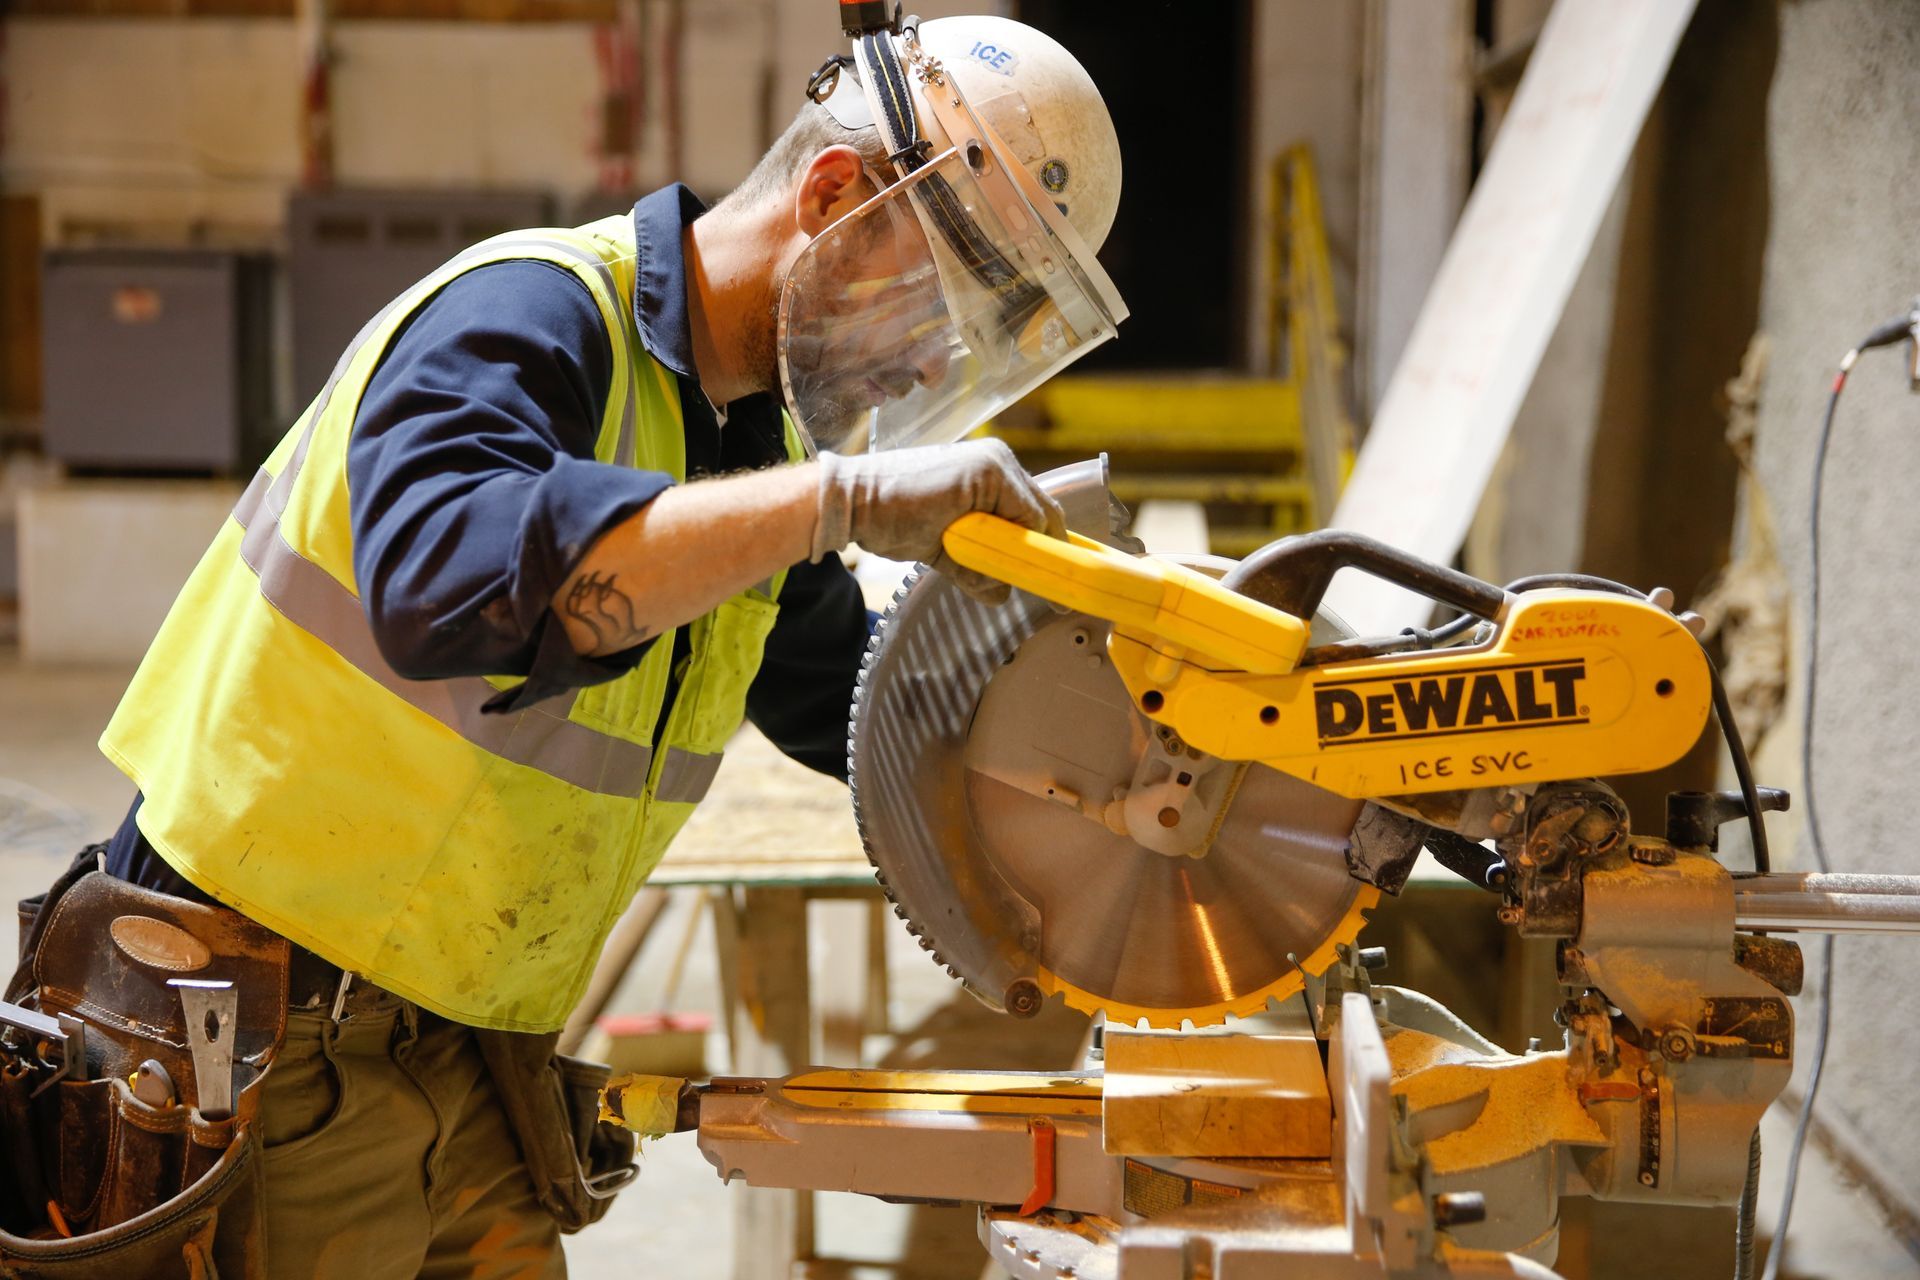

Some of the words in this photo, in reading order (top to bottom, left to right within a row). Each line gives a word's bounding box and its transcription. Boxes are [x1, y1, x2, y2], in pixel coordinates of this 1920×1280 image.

[970, 41, 1012, 69] ICE
[1400, 756, 1454, 785] ICE
[1471, 751, 1533, 775] SVC
